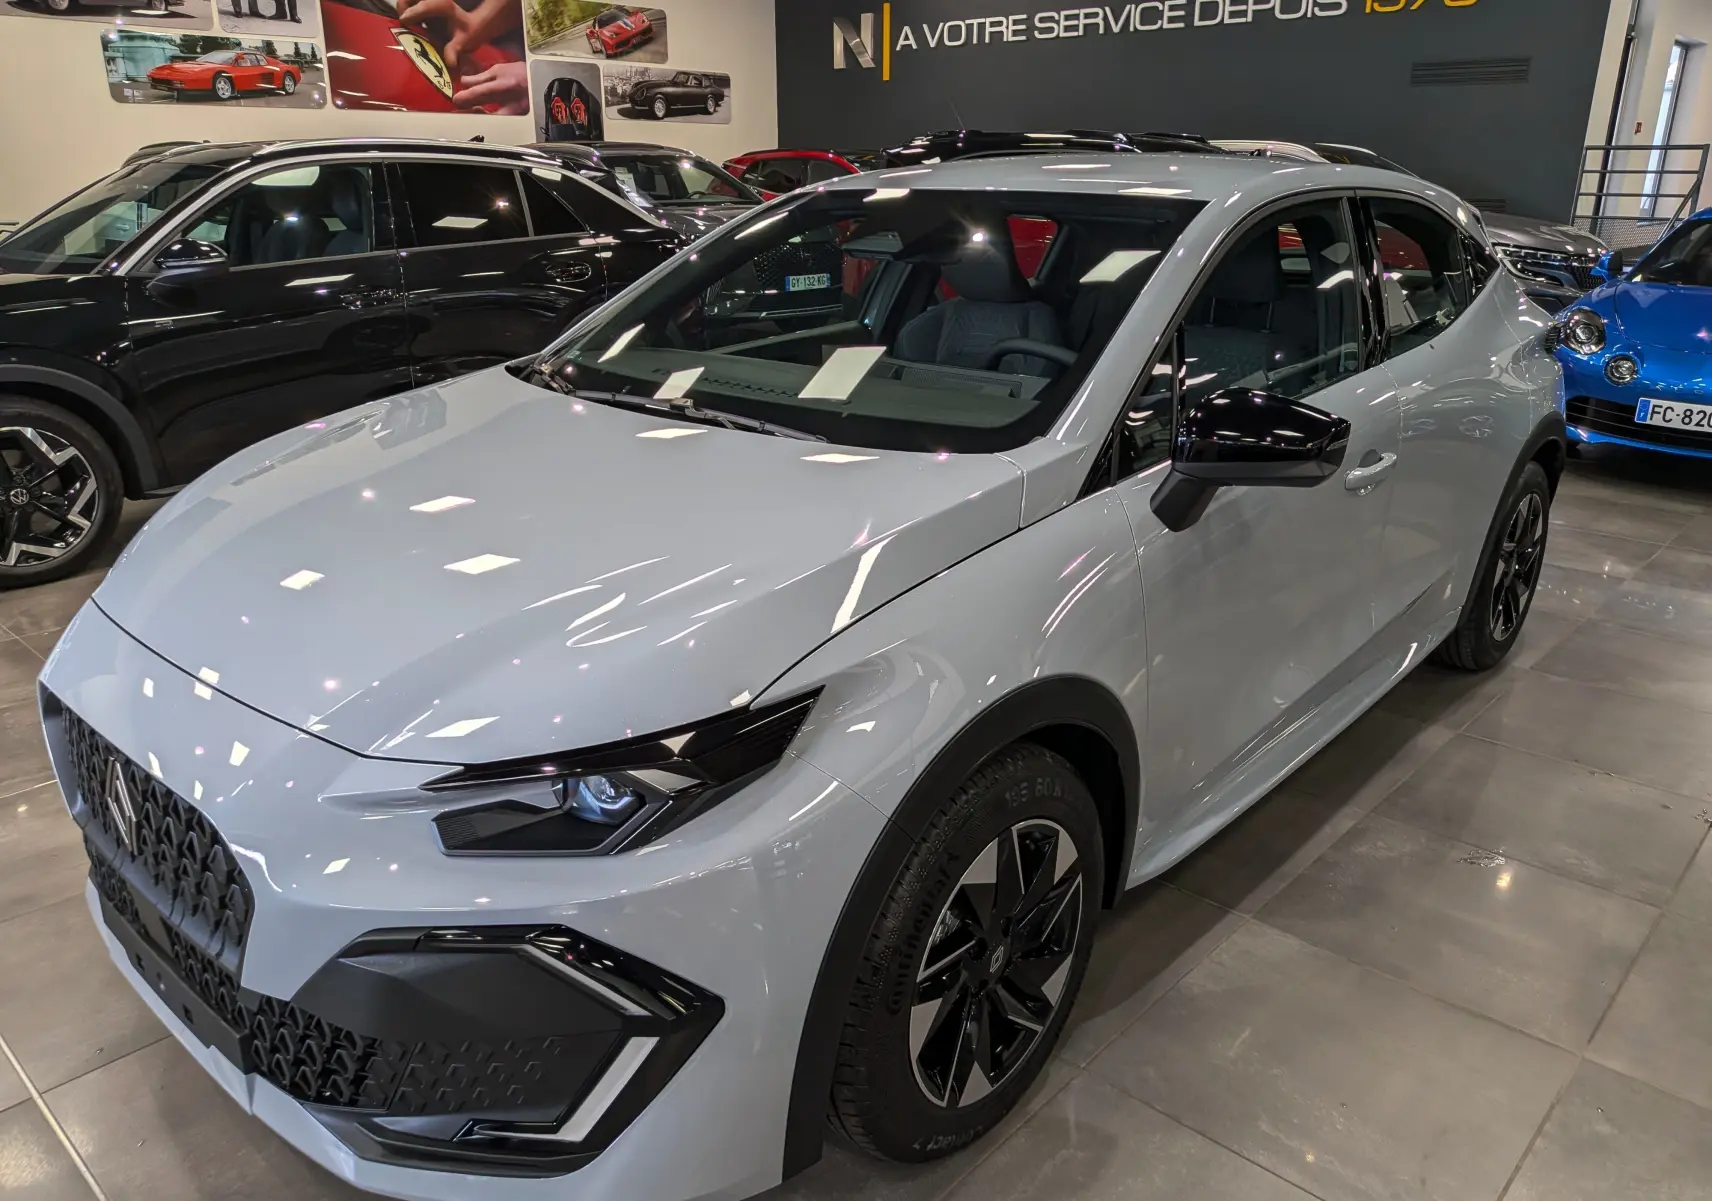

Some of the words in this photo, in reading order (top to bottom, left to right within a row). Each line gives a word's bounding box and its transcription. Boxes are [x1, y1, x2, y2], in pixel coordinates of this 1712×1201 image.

[833, 13, 876, 69] N
[896, 26, 918, 51] A
[923, 14, 1028, 48] VOTRE
[1034, 0, 1188, 39] SERVICE
[1193, 0, 1348, 26] DEPUIS
[791, 275, 826, 288] GY-132-KG
